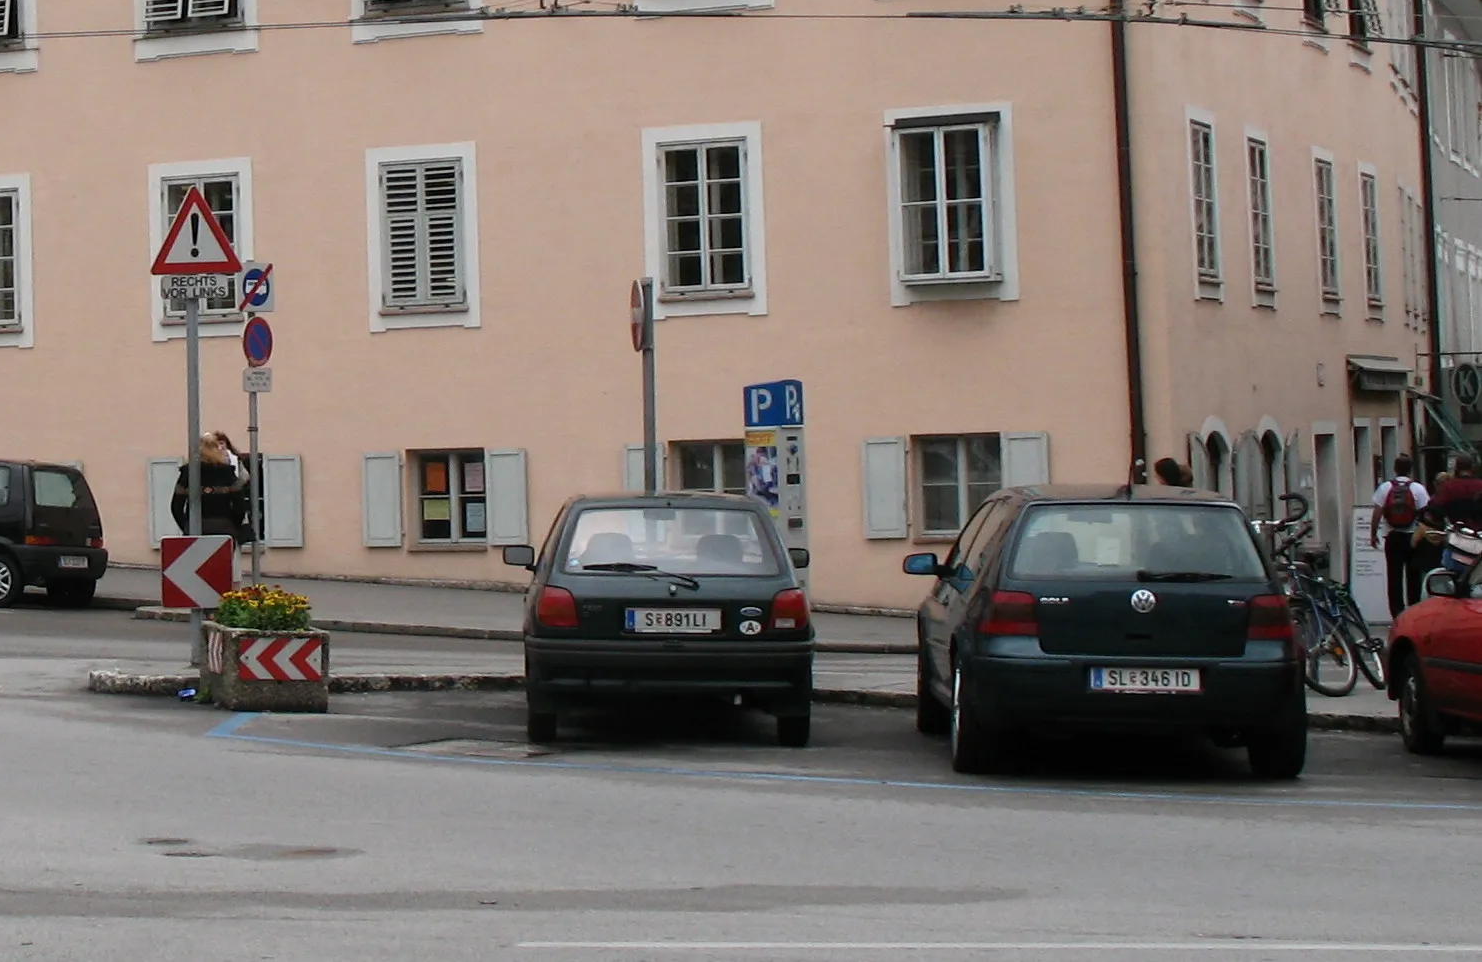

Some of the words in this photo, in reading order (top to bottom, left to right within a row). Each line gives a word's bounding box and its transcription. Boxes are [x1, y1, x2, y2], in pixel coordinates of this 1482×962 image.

[171, 276, 217, 287] RECHTS
[163, 287, 187, 299] VOR
[193, 286, 226, 298] LINKS
[751, 388, 772, 423] P
[745, 622, 756, 633] A
[1108, 670, 1127, 686] SL
